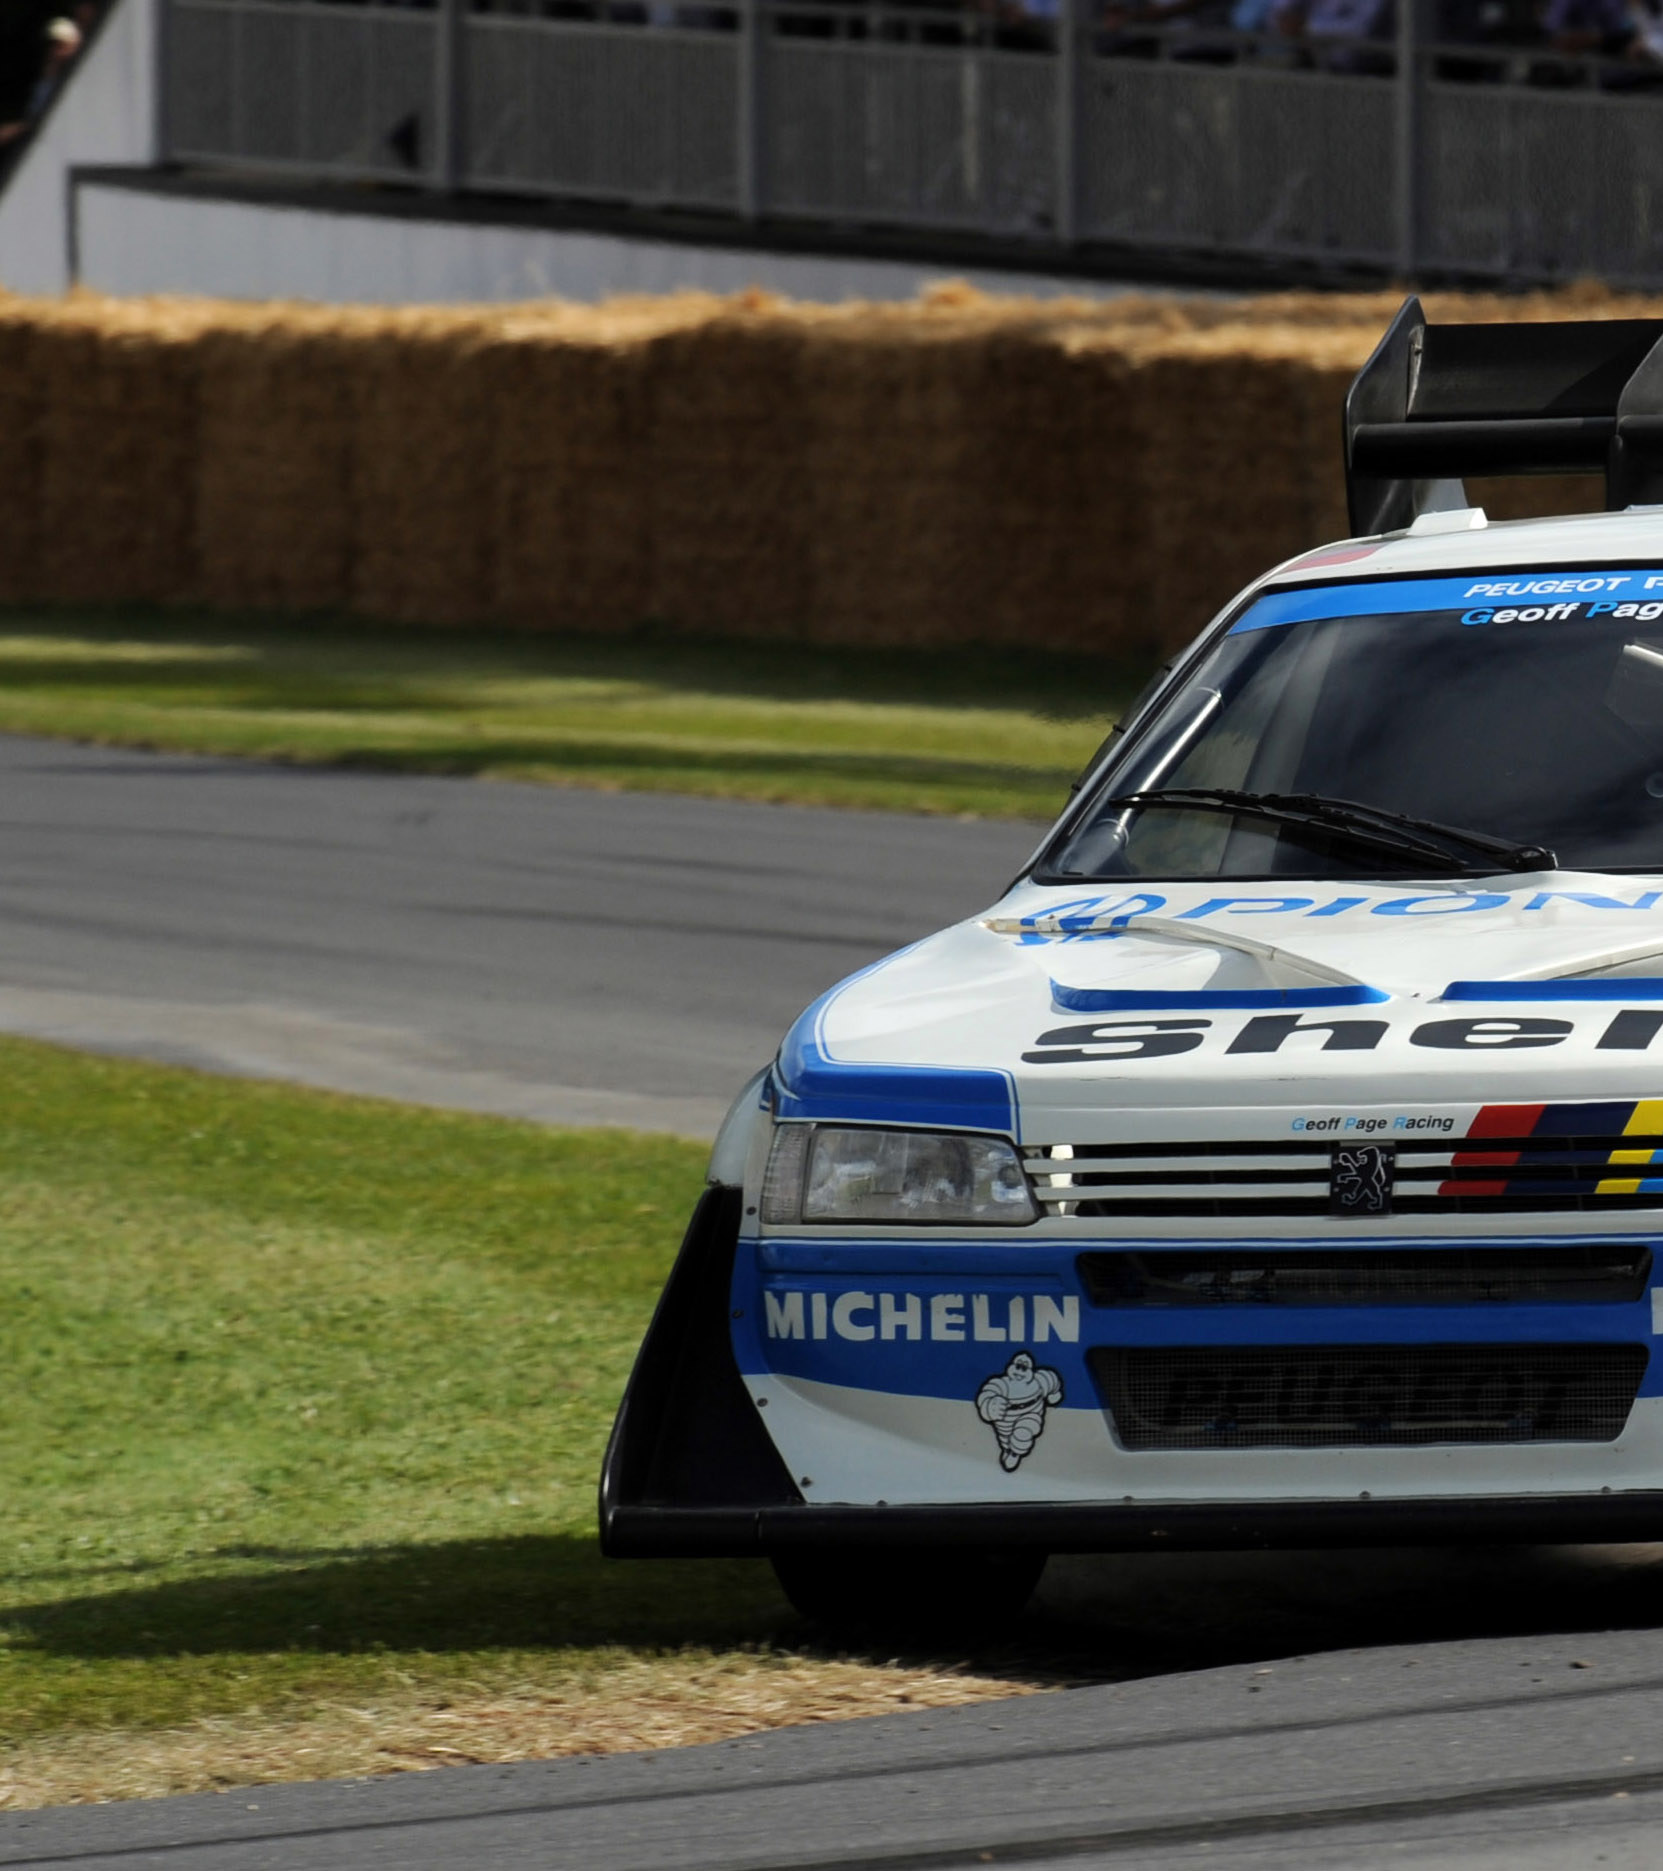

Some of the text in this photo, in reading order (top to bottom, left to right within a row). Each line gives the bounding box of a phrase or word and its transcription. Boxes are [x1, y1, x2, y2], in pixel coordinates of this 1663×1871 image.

[1463, 577, 1631, 598] PEUGEOT
[1460, 602, 1580, 625] Geoff
[1291, 1115, 1455, 1133] Geoff Page Racing
[764, 1290, 1079, 1343] MICHELIN
